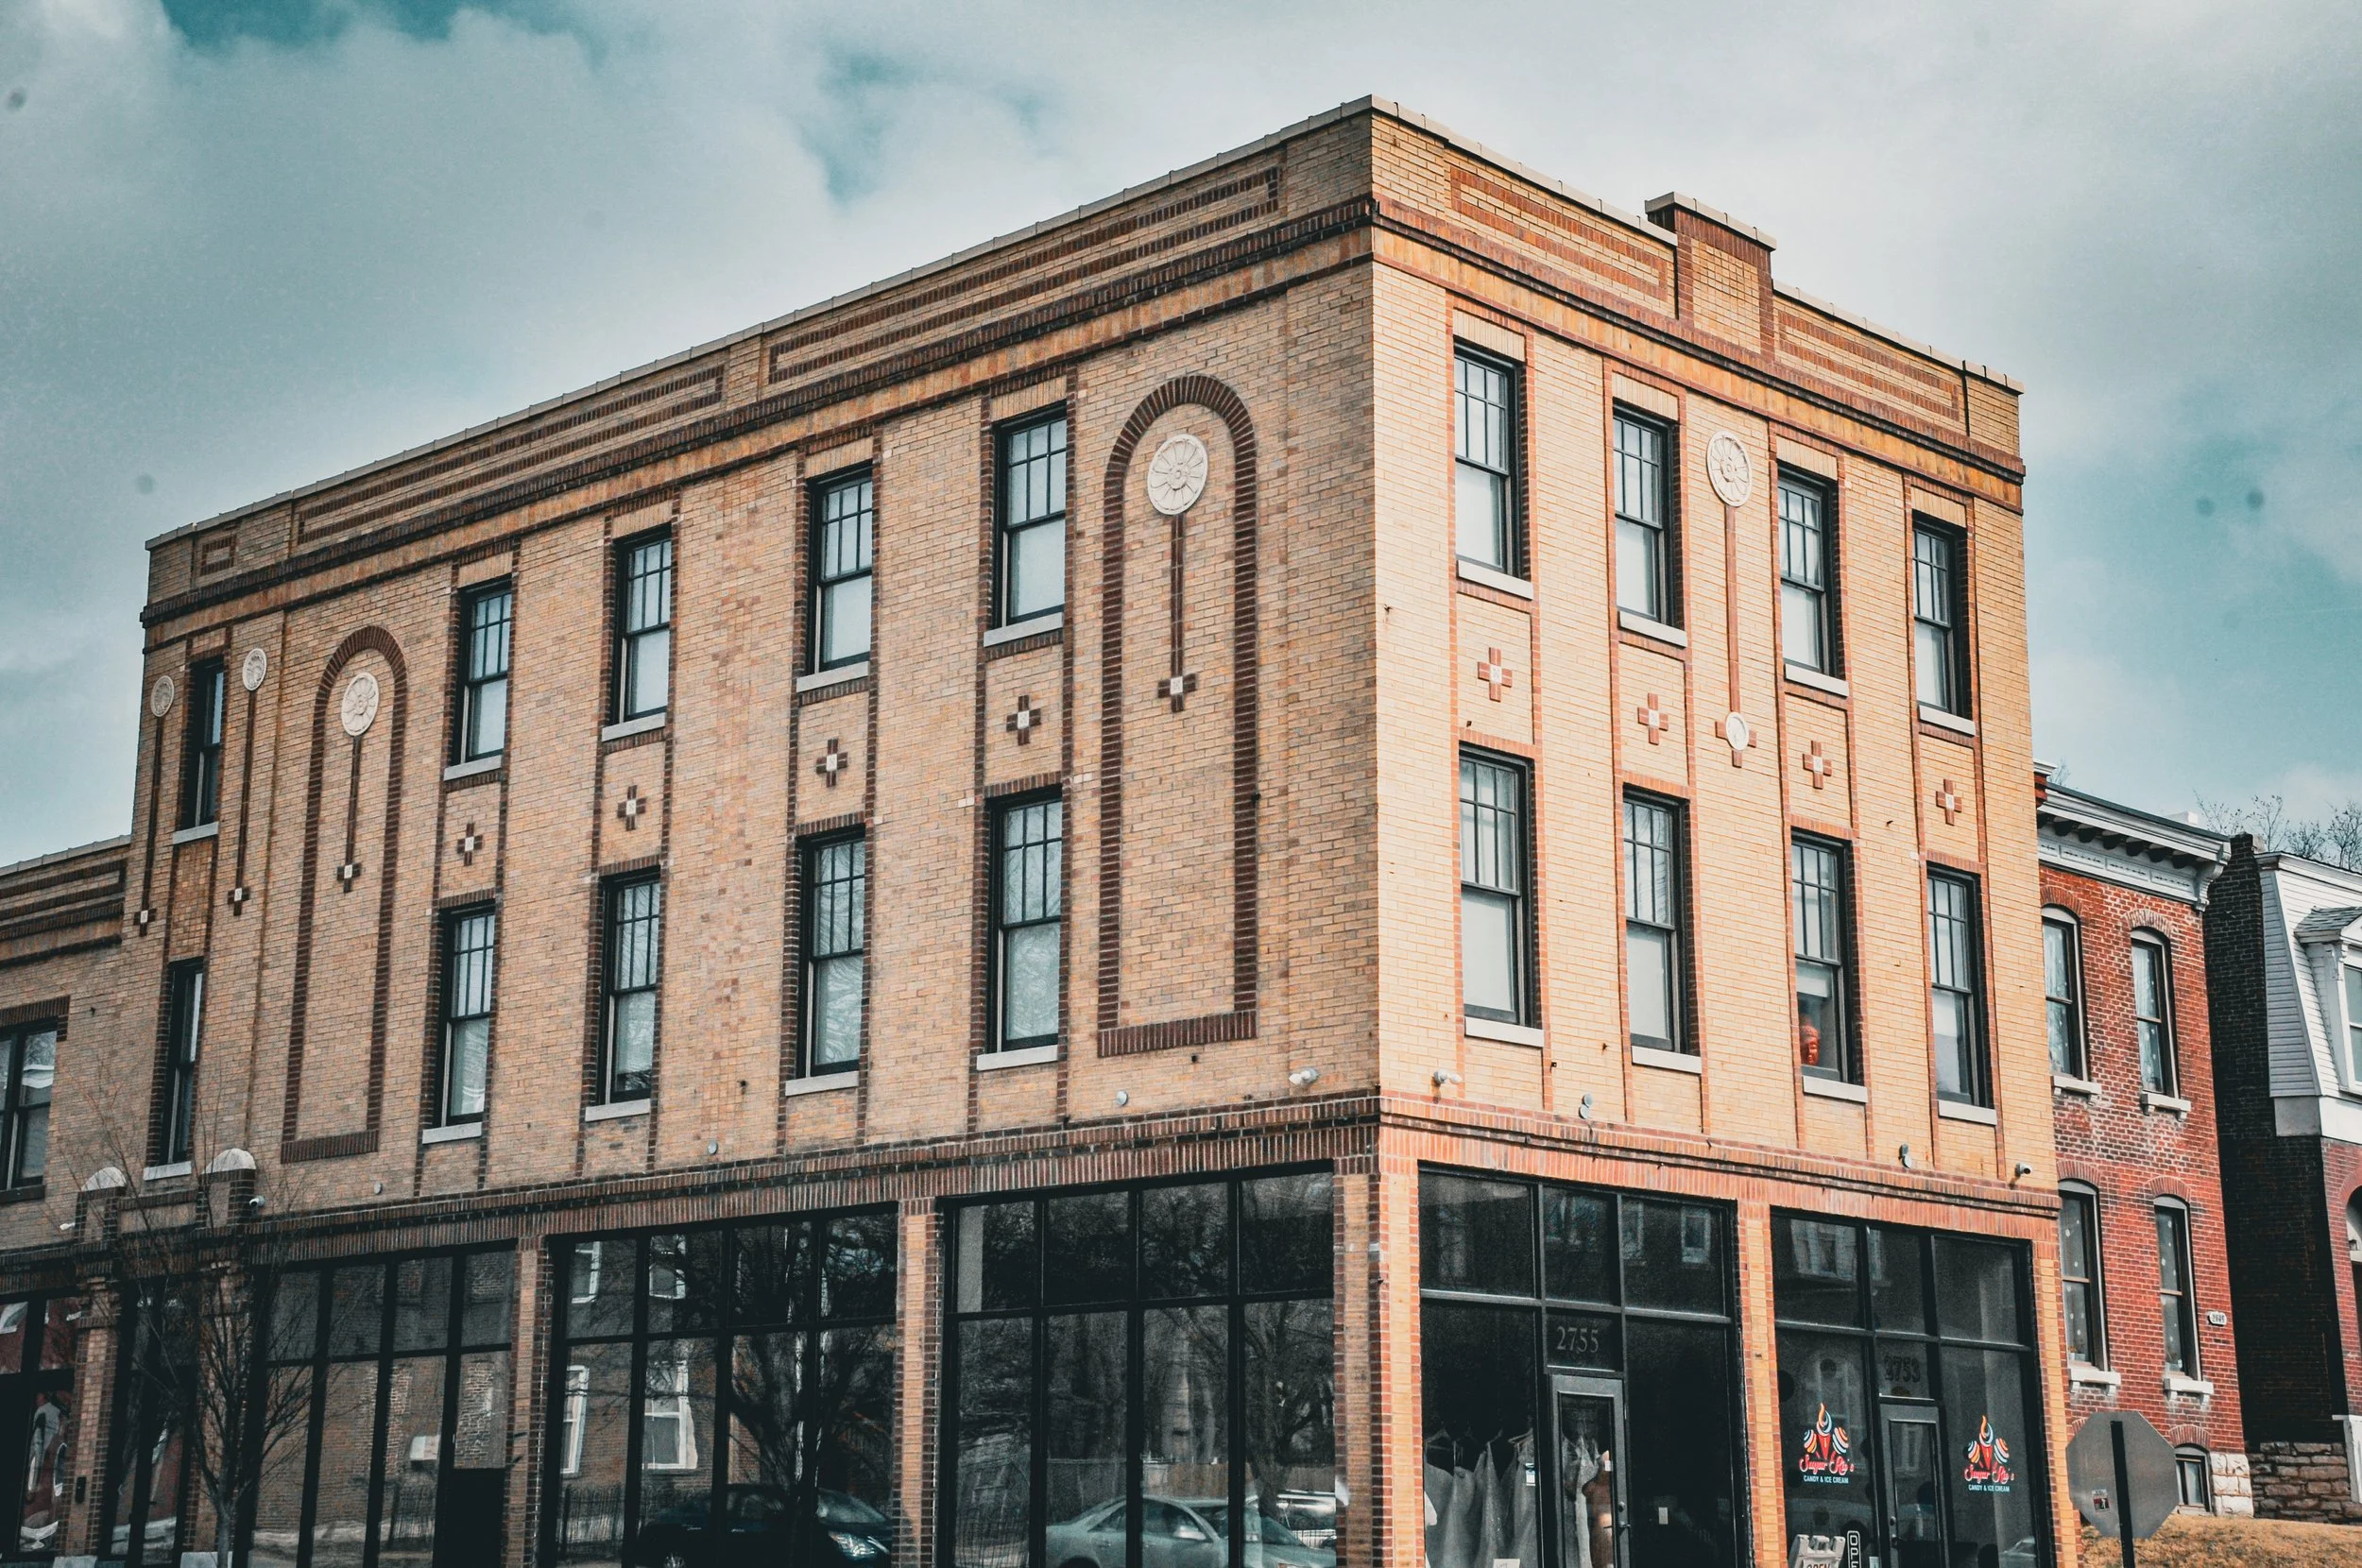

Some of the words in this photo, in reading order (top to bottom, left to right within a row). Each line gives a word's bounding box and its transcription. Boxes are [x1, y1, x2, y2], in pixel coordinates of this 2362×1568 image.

[1557, 1326, 1599, 1353] 2755
[1799, 1455, 1827, 1474] Sugar
[1964, 1464, 1991, 1484] Sugar
